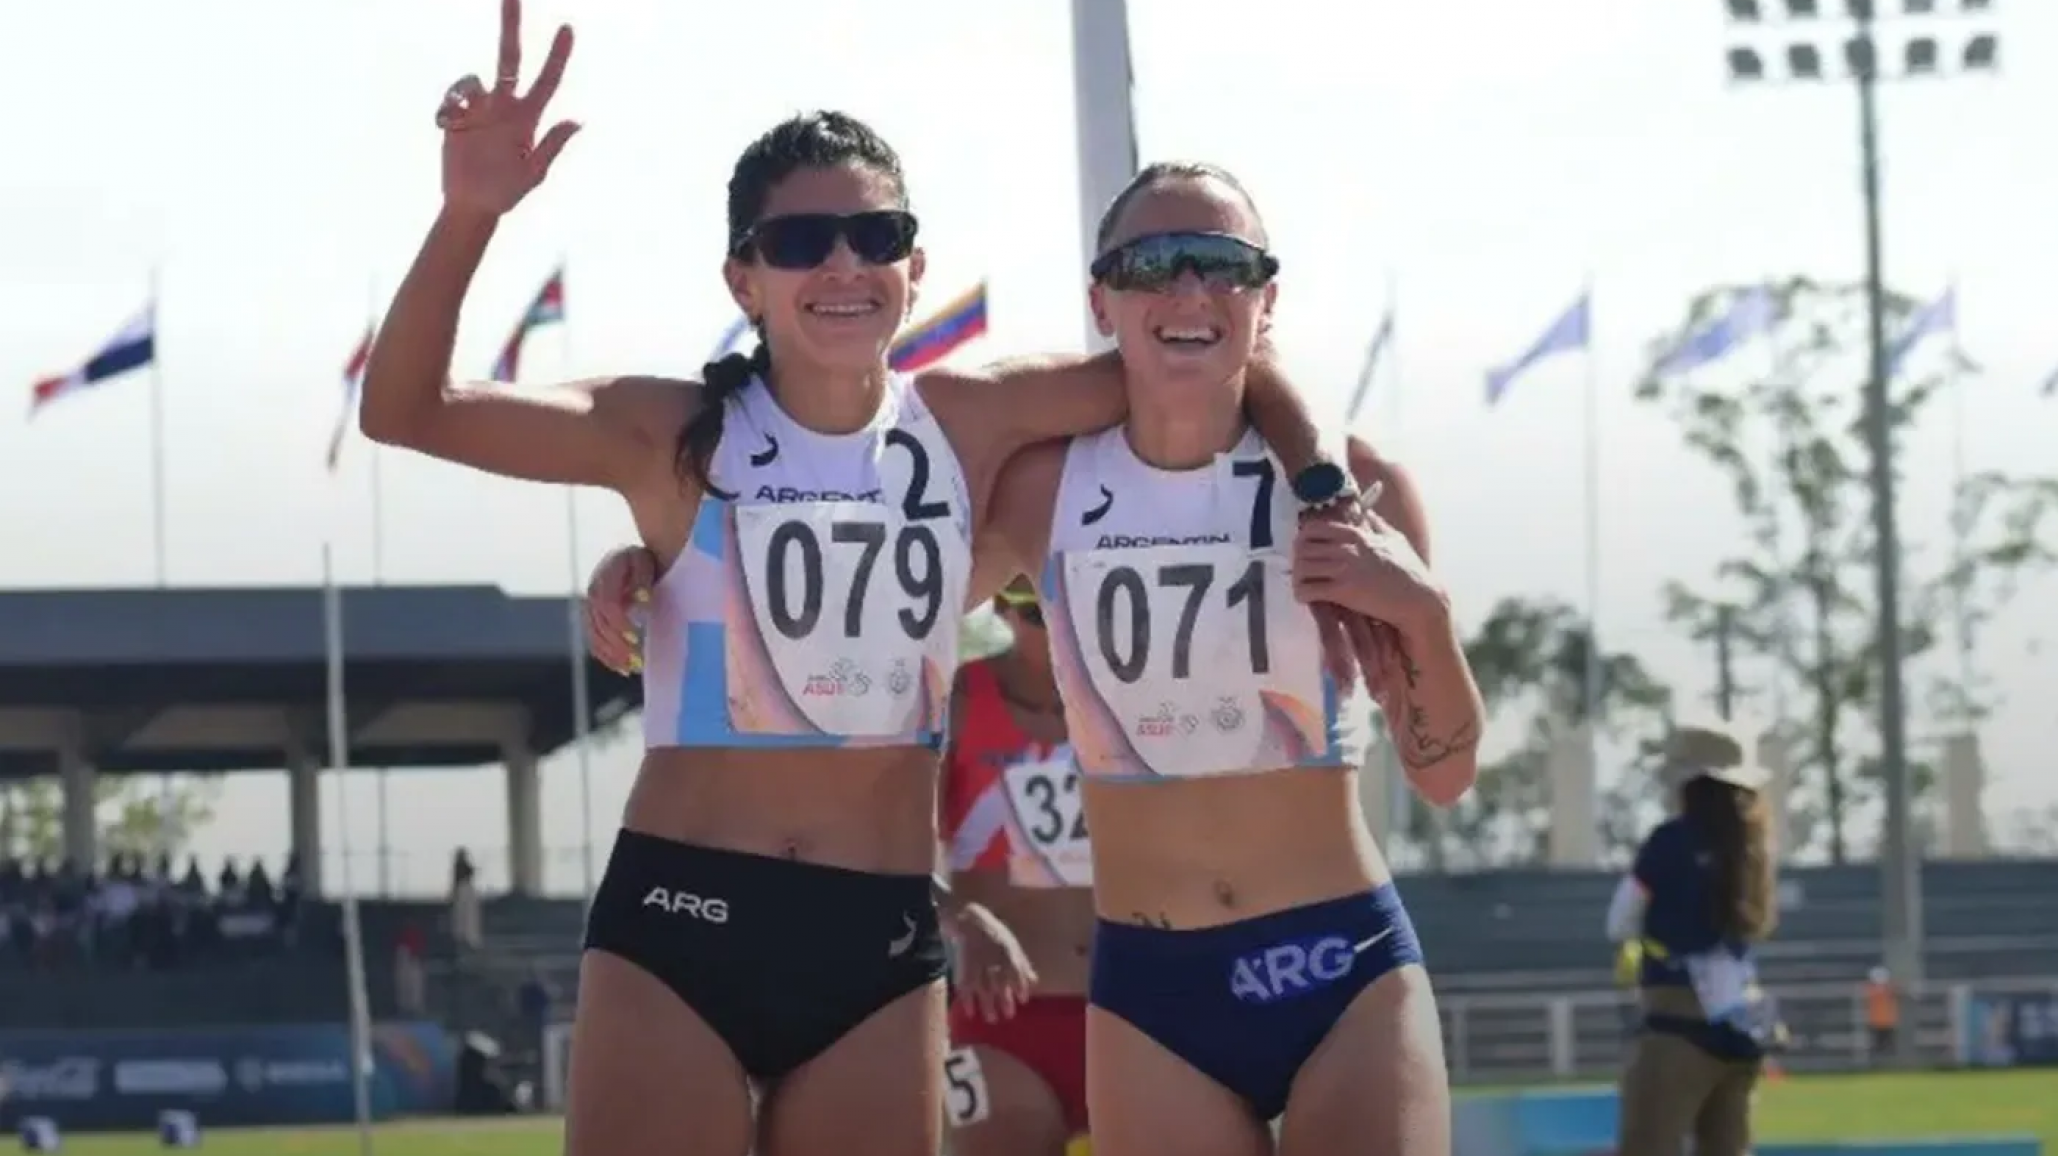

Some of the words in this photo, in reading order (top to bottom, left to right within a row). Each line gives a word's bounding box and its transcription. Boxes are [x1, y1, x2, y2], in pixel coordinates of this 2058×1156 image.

[885, 428, 951, 520] 2
[1233, 459, 1275, 548] 7
[766, 520, 943, 640] 079
[1097, 560, 1269, 684] 071
[643, 886, 729, 923] ARG
[1231, 937, 1355, 1001] ARG
[944, 1055, 977, 1119] 5
